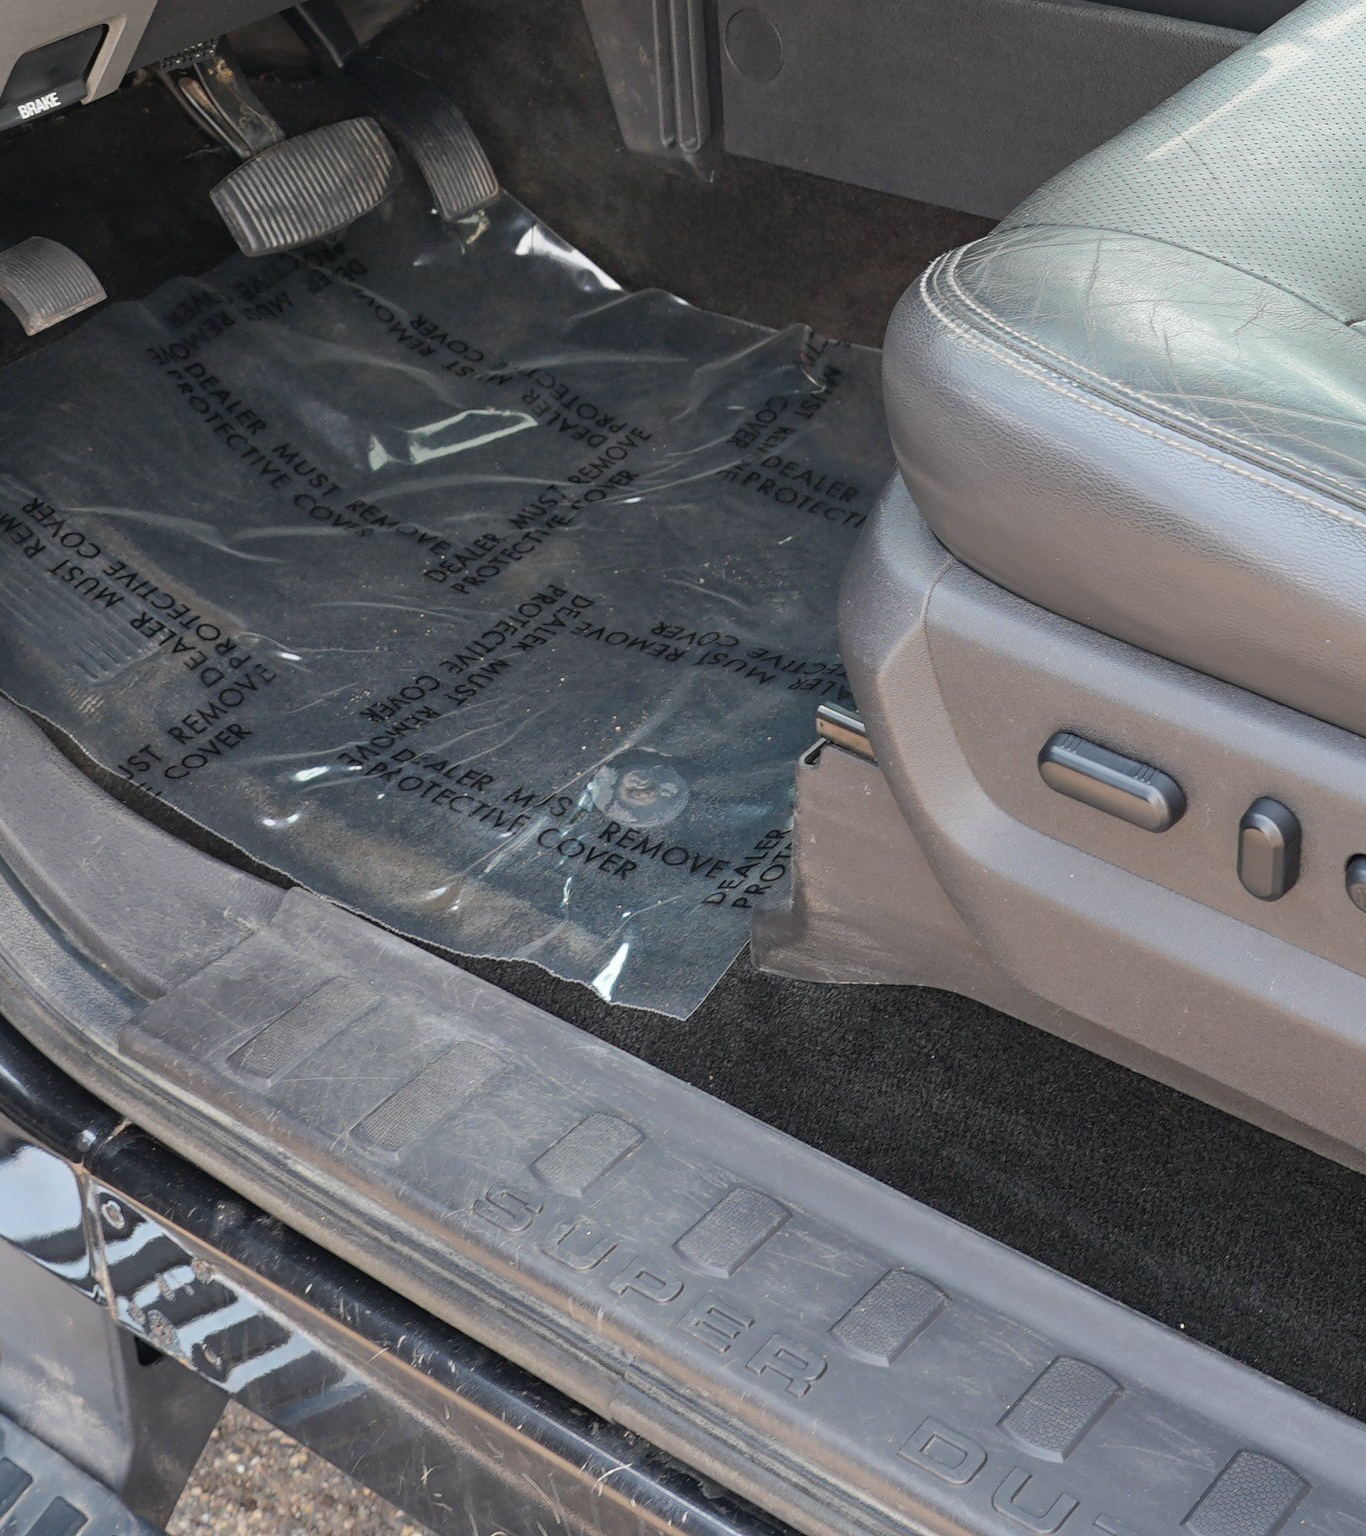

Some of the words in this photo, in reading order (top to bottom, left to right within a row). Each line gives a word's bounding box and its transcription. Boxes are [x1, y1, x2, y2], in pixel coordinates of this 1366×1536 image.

[17, 92, 62, 120] BRAKE
[408, 314, 485, 364] COVER
[166, 368, 293, 490] PROTECTIVE
[183, 362, 267, 437] DEALER
[271, 442, 342, 498] MUST
[521, 388, 613, 450] DEALER
[423, 533, 503, 584] DEALER
[507, 485, 569, 530] MUST
[567, 426, 654, 485] REMOVE
[761, 455, 859, 504] DEALER
[21, 496, 102, 561] COVER
[46, 558, 125, 610] MUST
[101, 559, 254, 670] PROTECTIVE
[129, 613, 228, 689] DEALER
[438, 583, 568, 675] PROTECTIVE
[512, 593, 595, 653] DEALER
[650, 621, 740, 648] COVER
[443, 657, 512, 706] MUST
[693, 649, 778, 686] MUST
[167, 663, 278, 746] REMOVE
[360, 674, 441, 724] COVER
[164, 722, 254, 780] COVER
[337, 704, 443, 767] REMOVE
[535, 827, 638, 882] COVER
[597, 821, 729, 880] REMOVE
[703, 828, 794, 907] DEALER
[471, 1183, 829, 1400] SUPER
